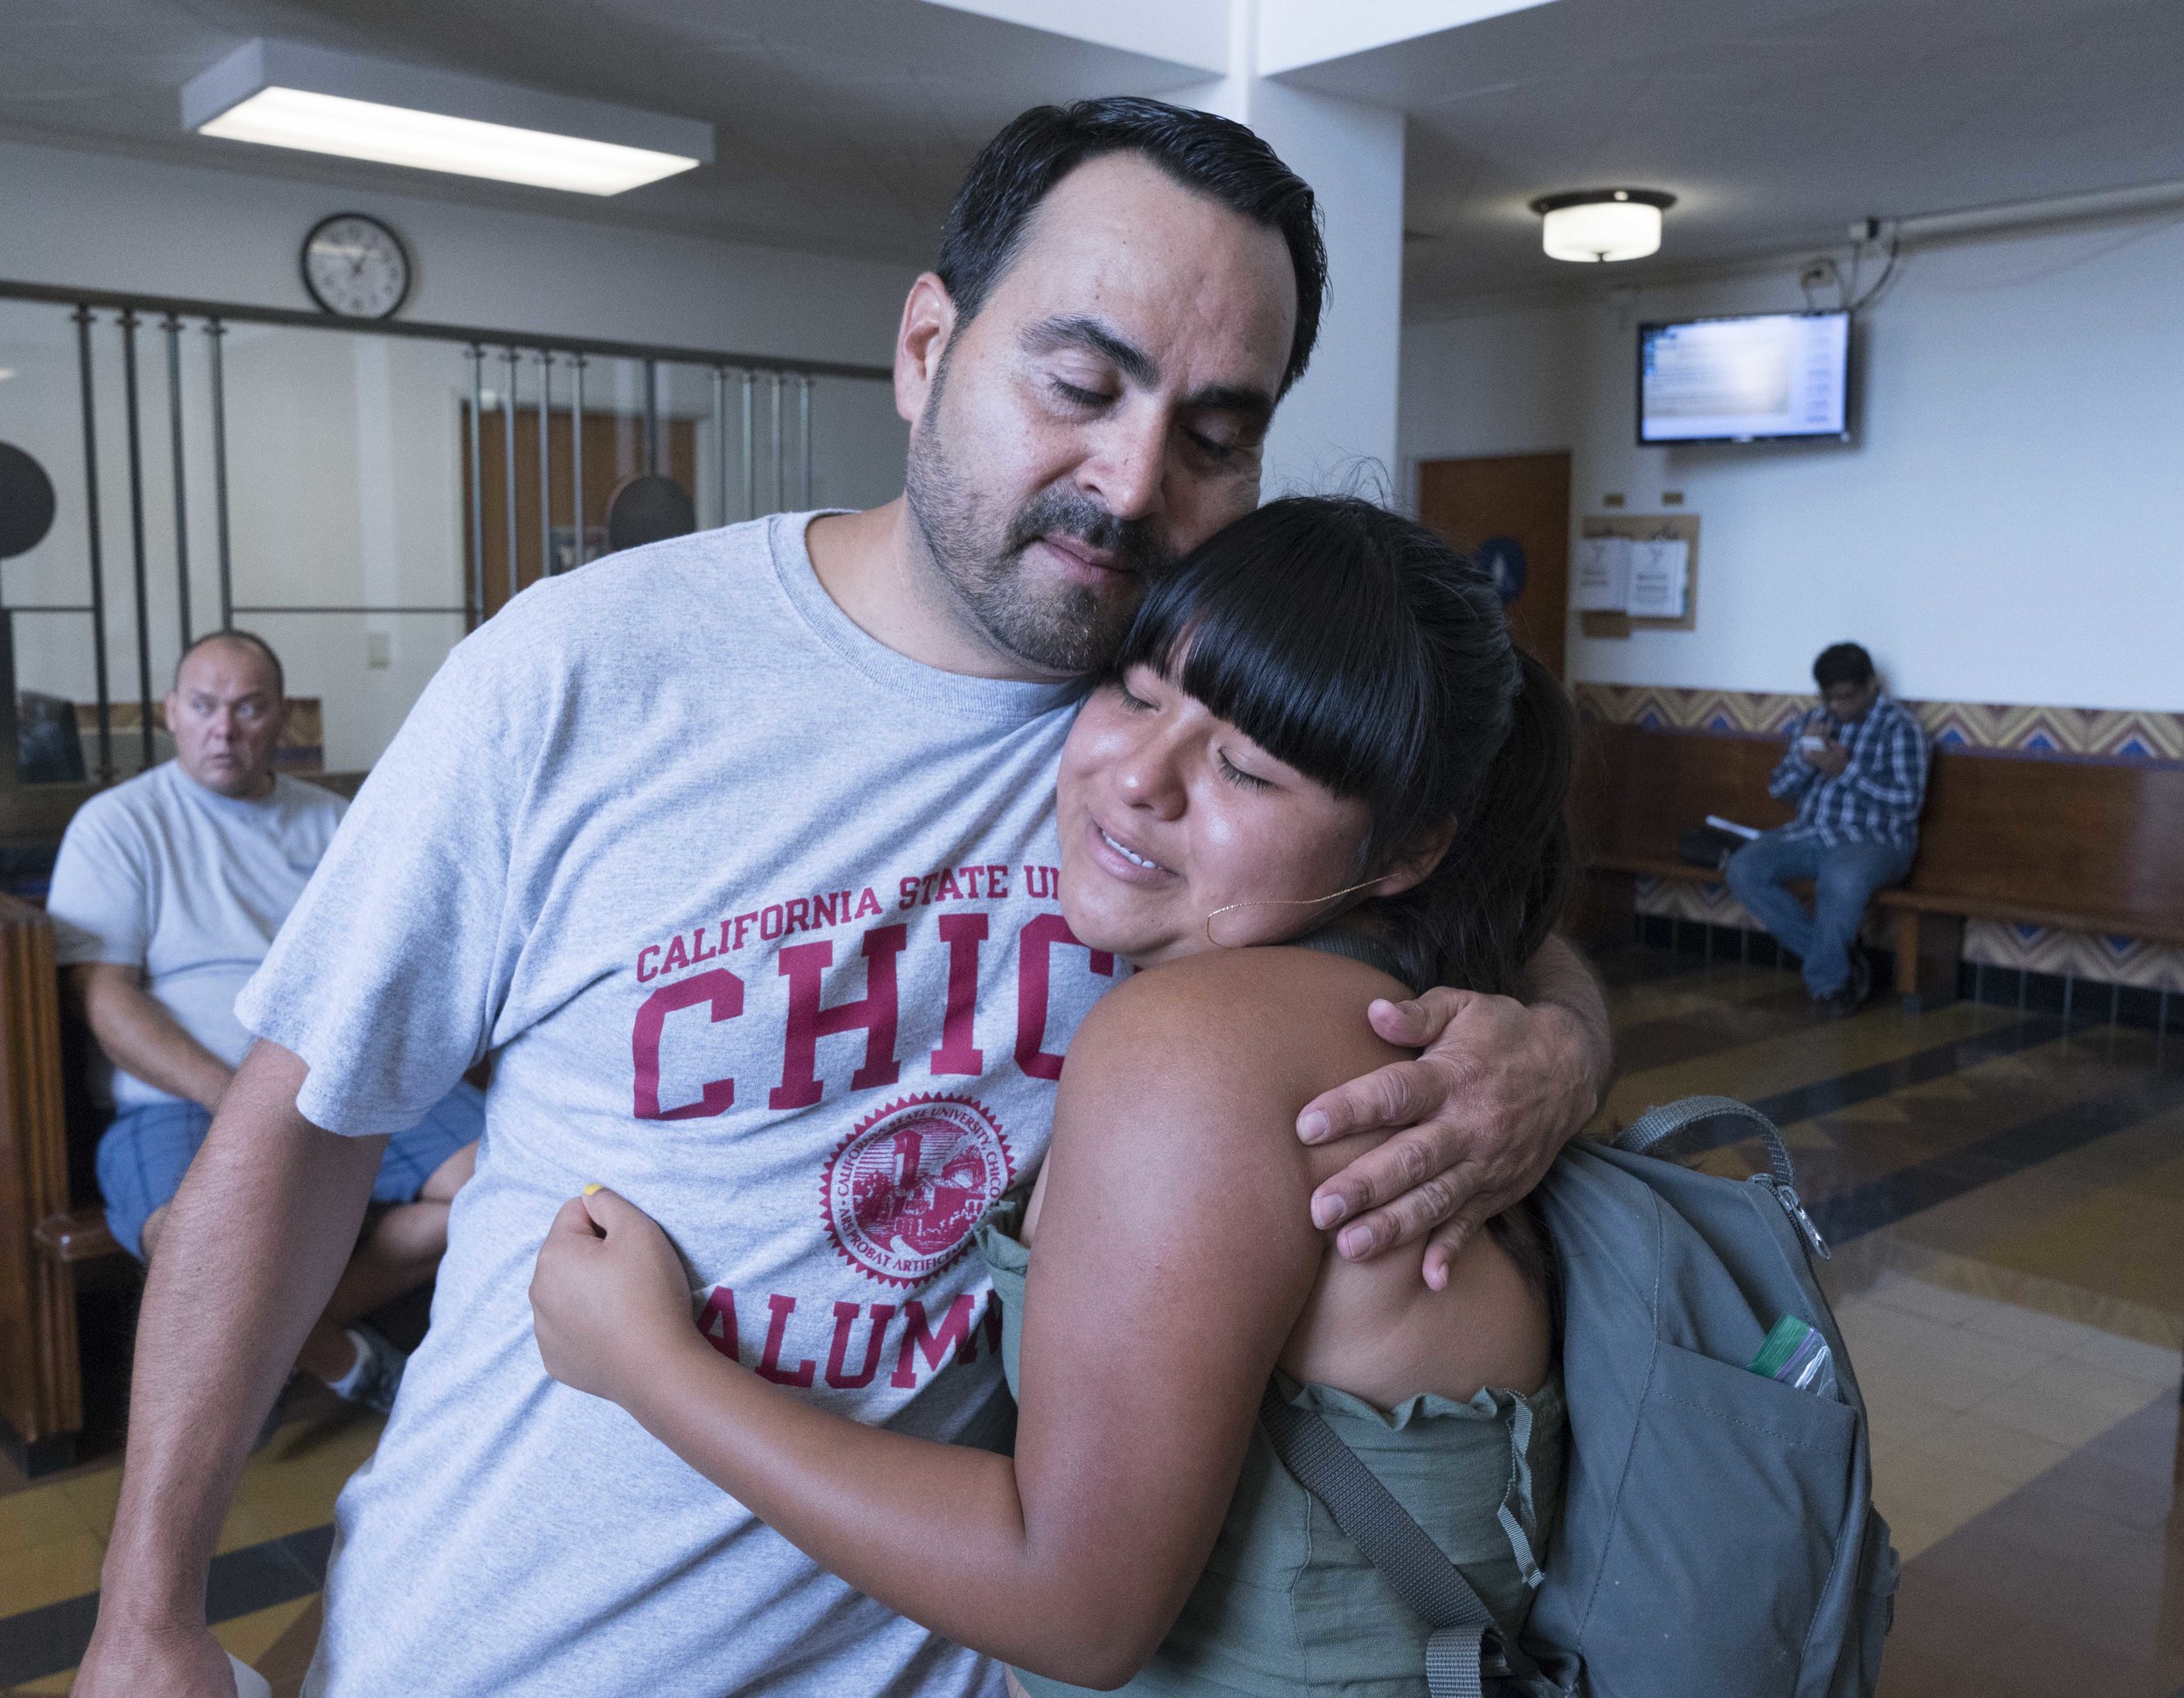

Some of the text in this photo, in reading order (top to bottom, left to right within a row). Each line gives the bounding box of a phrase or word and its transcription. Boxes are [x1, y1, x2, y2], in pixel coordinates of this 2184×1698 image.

[636, 887, 883, 984] CALIFORNIA
[899, 865, 1009, 910] STATE
[632, 913, 1115, 1121] CHIC
[985, 1150, 1002, 1198] CHICO
[847, 1229, 892, 1267] PROBAT
